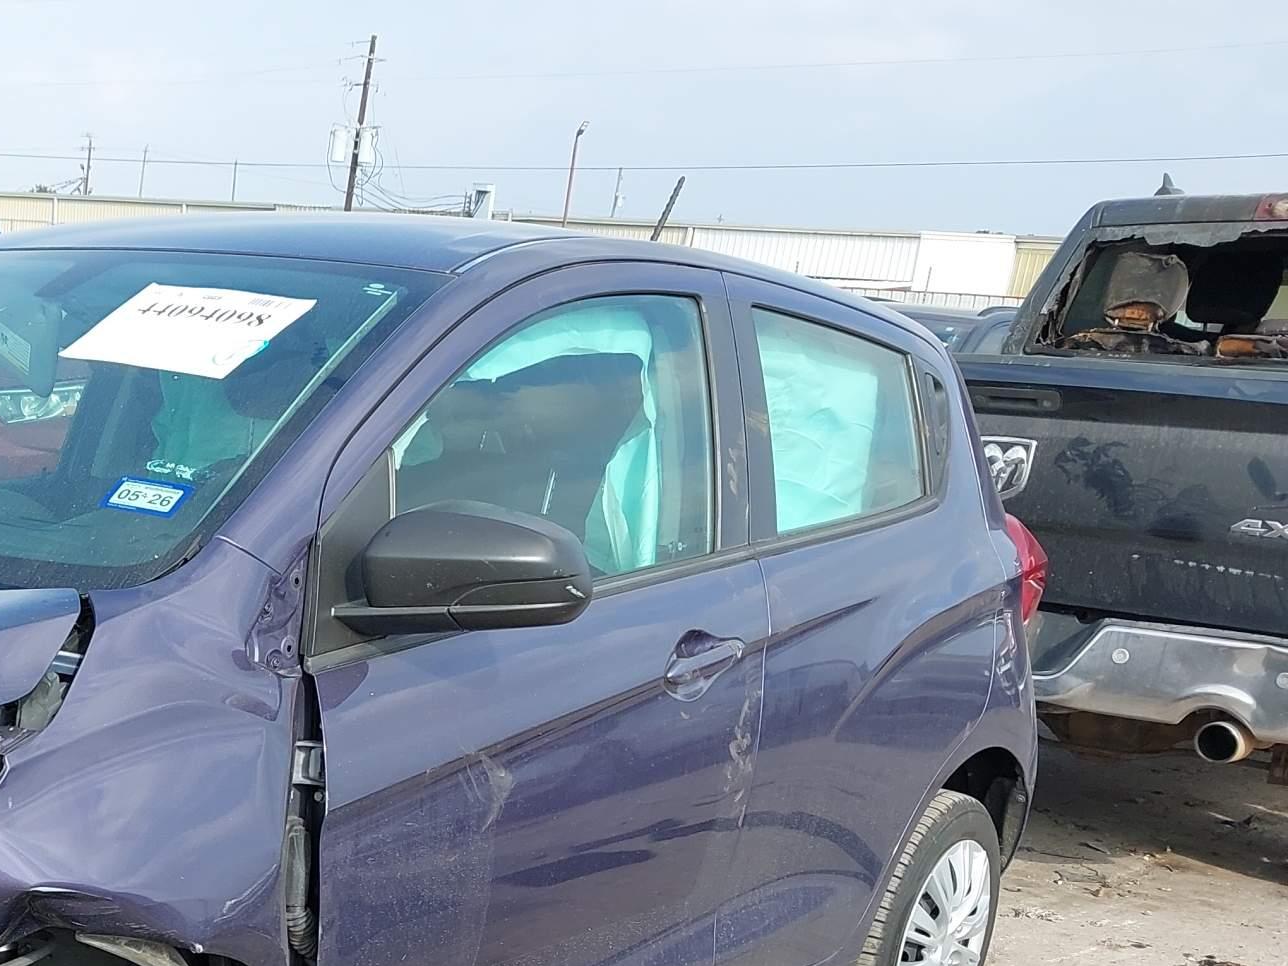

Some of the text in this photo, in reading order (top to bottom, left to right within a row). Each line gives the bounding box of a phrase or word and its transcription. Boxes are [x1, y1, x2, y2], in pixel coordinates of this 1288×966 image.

[138, 302, 272, 327] 44094098
[117, 488, 143, 502] 05
[146, 493, 173, 507] 26
